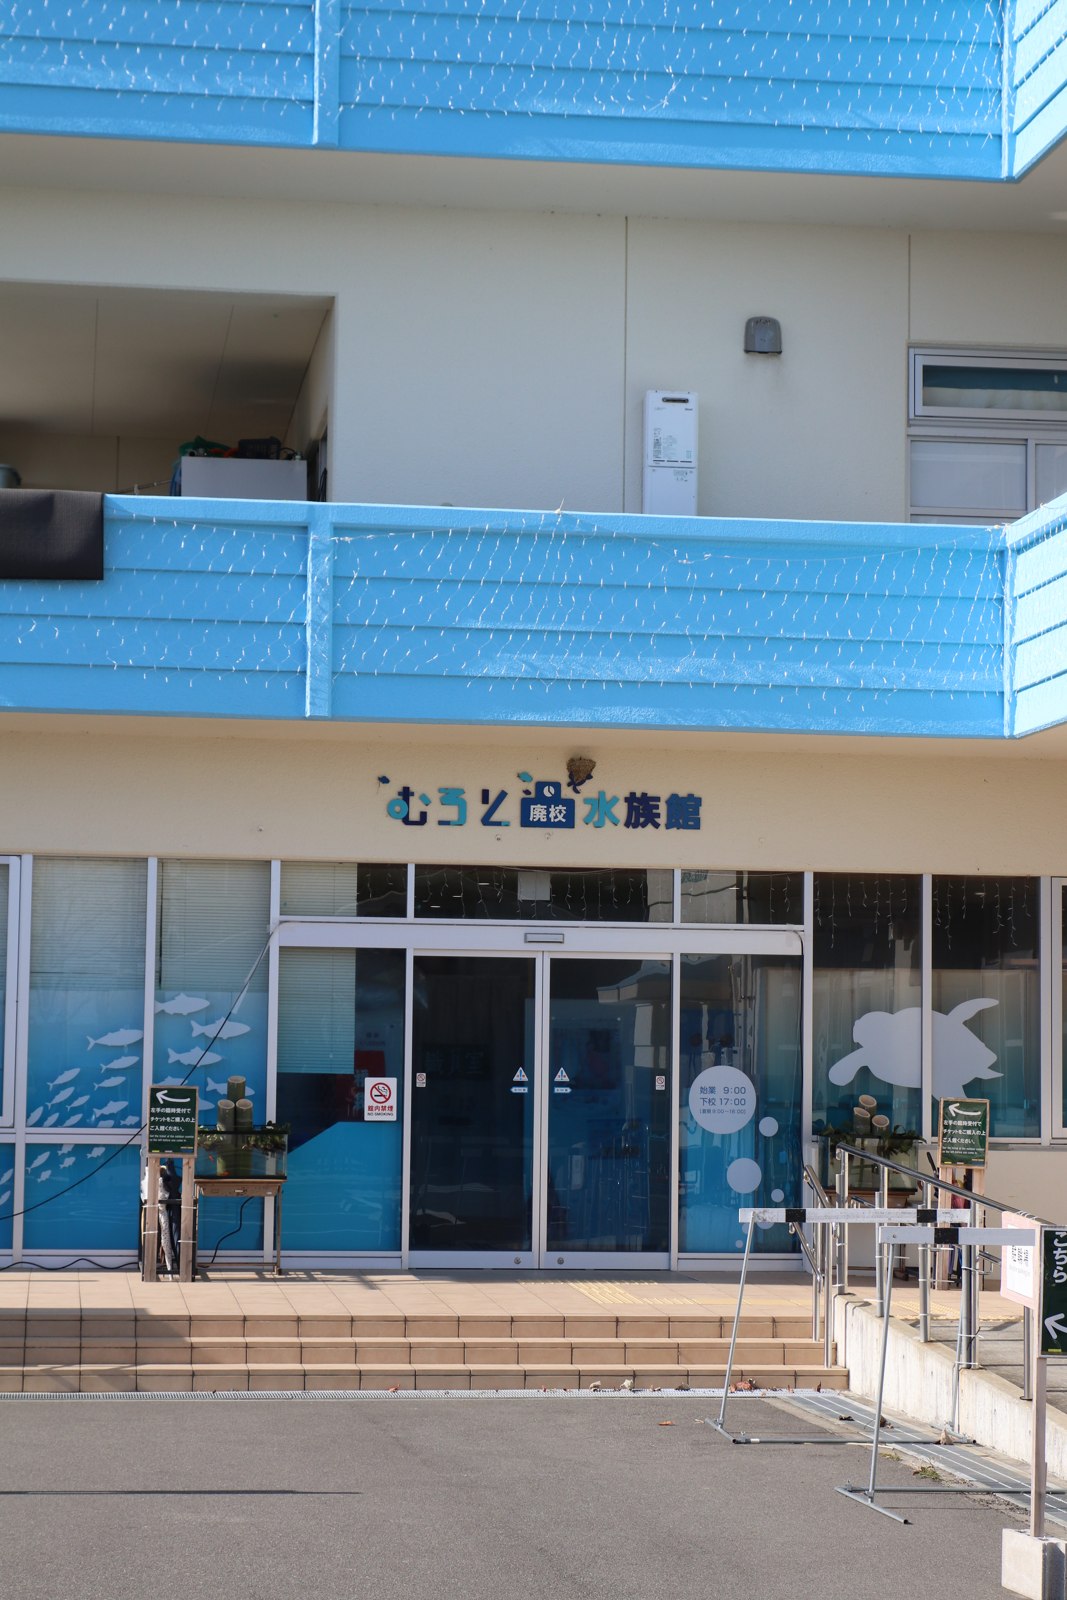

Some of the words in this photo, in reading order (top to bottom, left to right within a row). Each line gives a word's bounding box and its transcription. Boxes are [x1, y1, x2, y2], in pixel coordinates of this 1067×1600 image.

[699, 1086, 716, 1095] 始業
[723, 1086, 746, 1095] 9:00
[699, 1097, 716, 1106] 下校
[720, 1097, 746, 1106] 17:00
[367, 1104, 394, 1112] 館内禁煙
